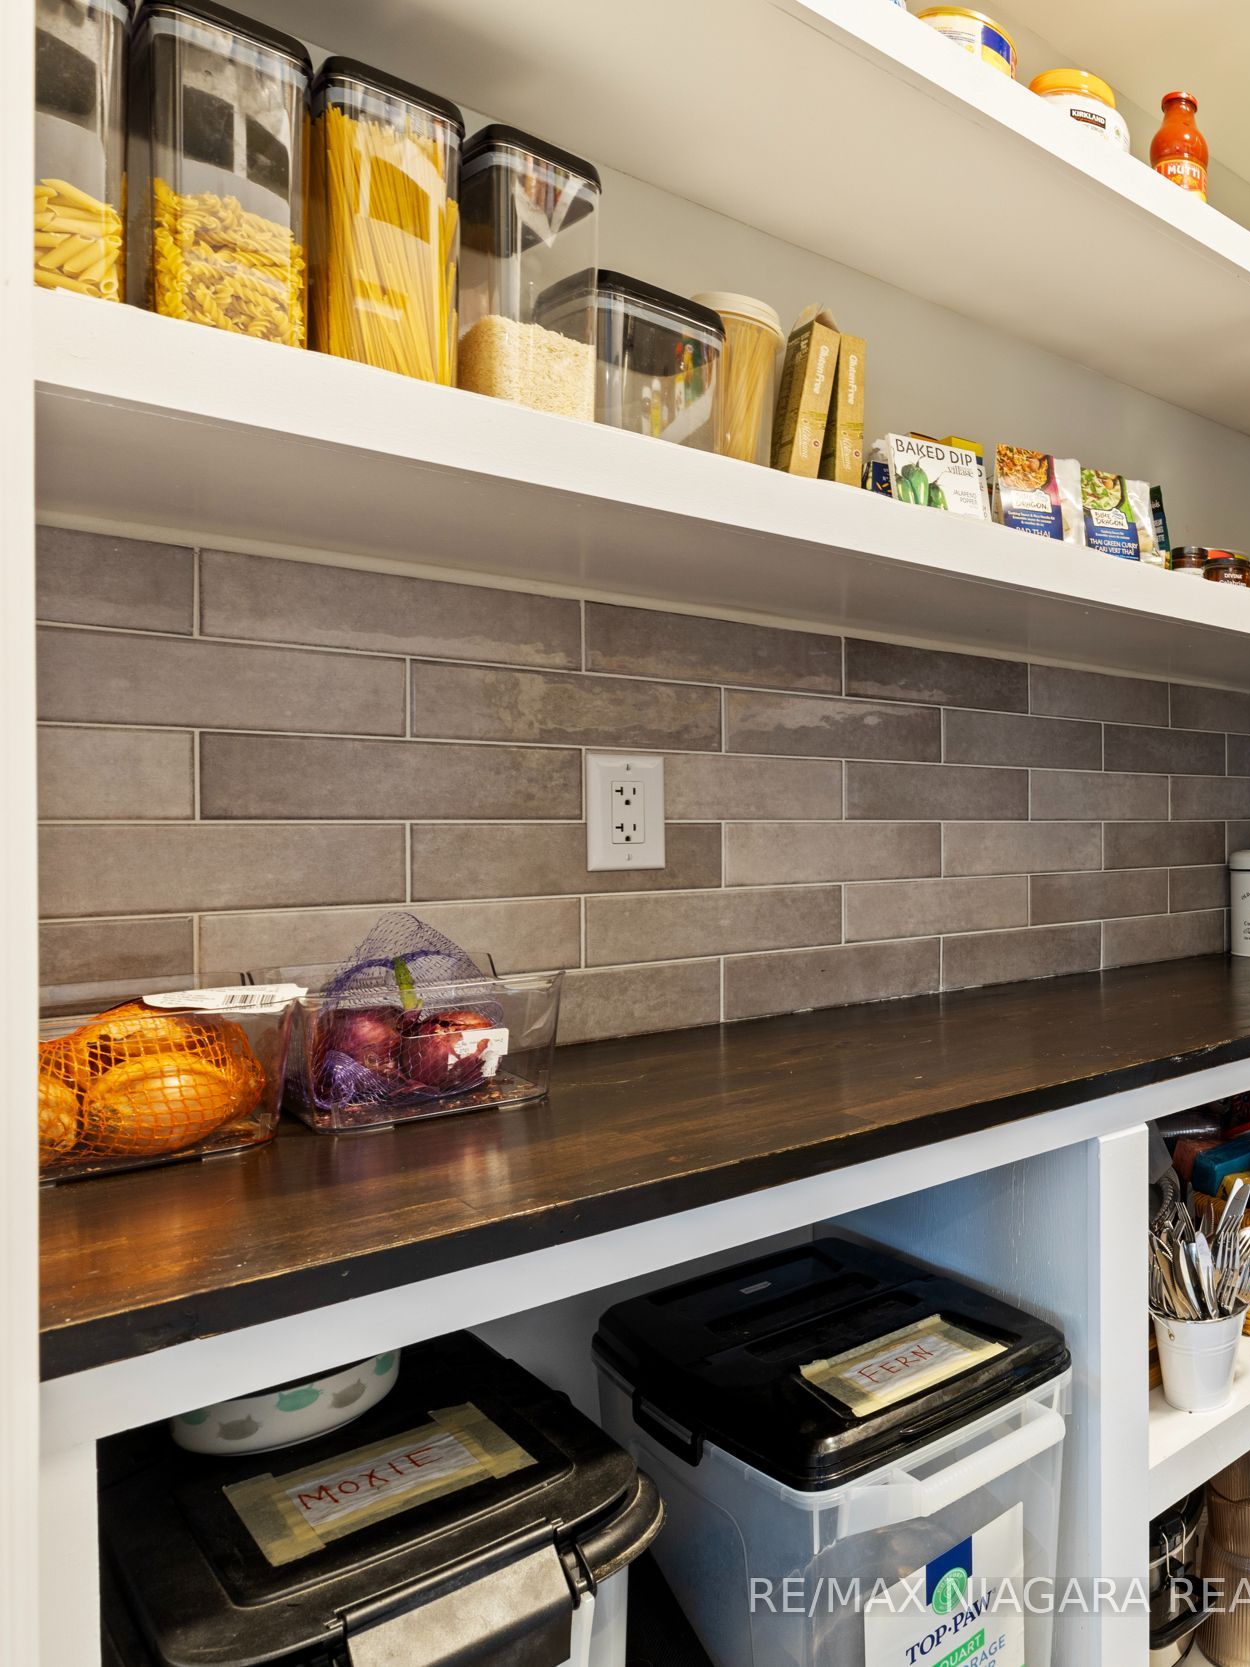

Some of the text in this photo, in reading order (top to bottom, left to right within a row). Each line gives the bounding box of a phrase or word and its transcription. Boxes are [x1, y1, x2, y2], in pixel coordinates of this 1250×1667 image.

[1072, 109, 1106, 125] KIRKLAND
[1167, 163, 1201, 180] MUTTI
[896, 438, 973, 467] BAKED DIP
[1103, 540, 1121, 548] GREEN
[1121, 541, 1139, 550] CURRY
[857, 1345, 934, 1385] FERN
[298, 1446, 442, 1510] MOXIE
